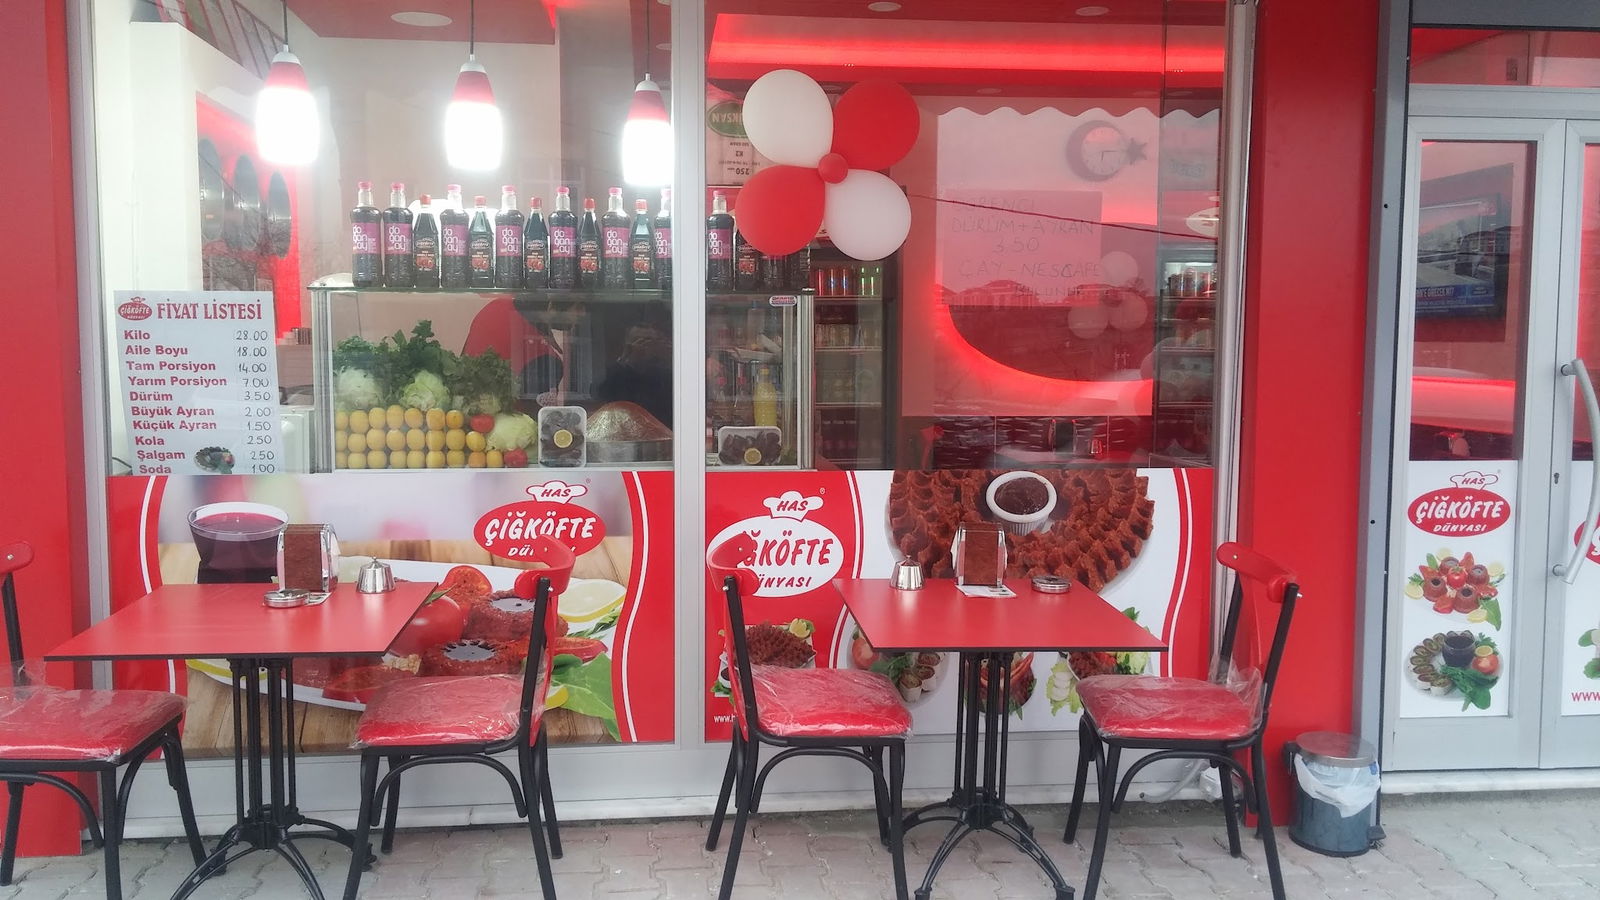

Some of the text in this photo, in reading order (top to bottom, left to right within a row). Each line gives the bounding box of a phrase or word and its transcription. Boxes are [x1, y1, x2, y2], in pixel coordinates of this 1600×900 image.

[157, 298, 262, 320] FİYAT LİSTESİ
[124, 329, 268, 341] Kilo 28.00
[125, 345, 267, 358] Aile Boyu 18.00
[126, 361, 267, 374] Tam Porsiyon 14.00
[128, 376, 166, 386] Yarım
[170, 376, 227, 388] Porsiyon
[129, 391, 173, 401] Dürüm
[131, 406, 173, 418] Büyük
[176, 406, 215, 418] Ayran
[132, 420, 175, 432] Küçük
[179, 420, 217, 432] Ayran
[135, 436, 165, 446] Kola
[137, 450, 186, 462] Şalgam
[139, 464, 172, 474] Soda
[1461, 477, 1486, 485] HAS
[541, 488, 572, 498] HAS
[776, 500, 808, 512] HAS
[1416, 495, 1504, 524] ÇİĞKÖFTE
[484, 511, 597, 547] ÇİĞKÖFTE
[1433, 523, 1487, 532] DÜNYASI
